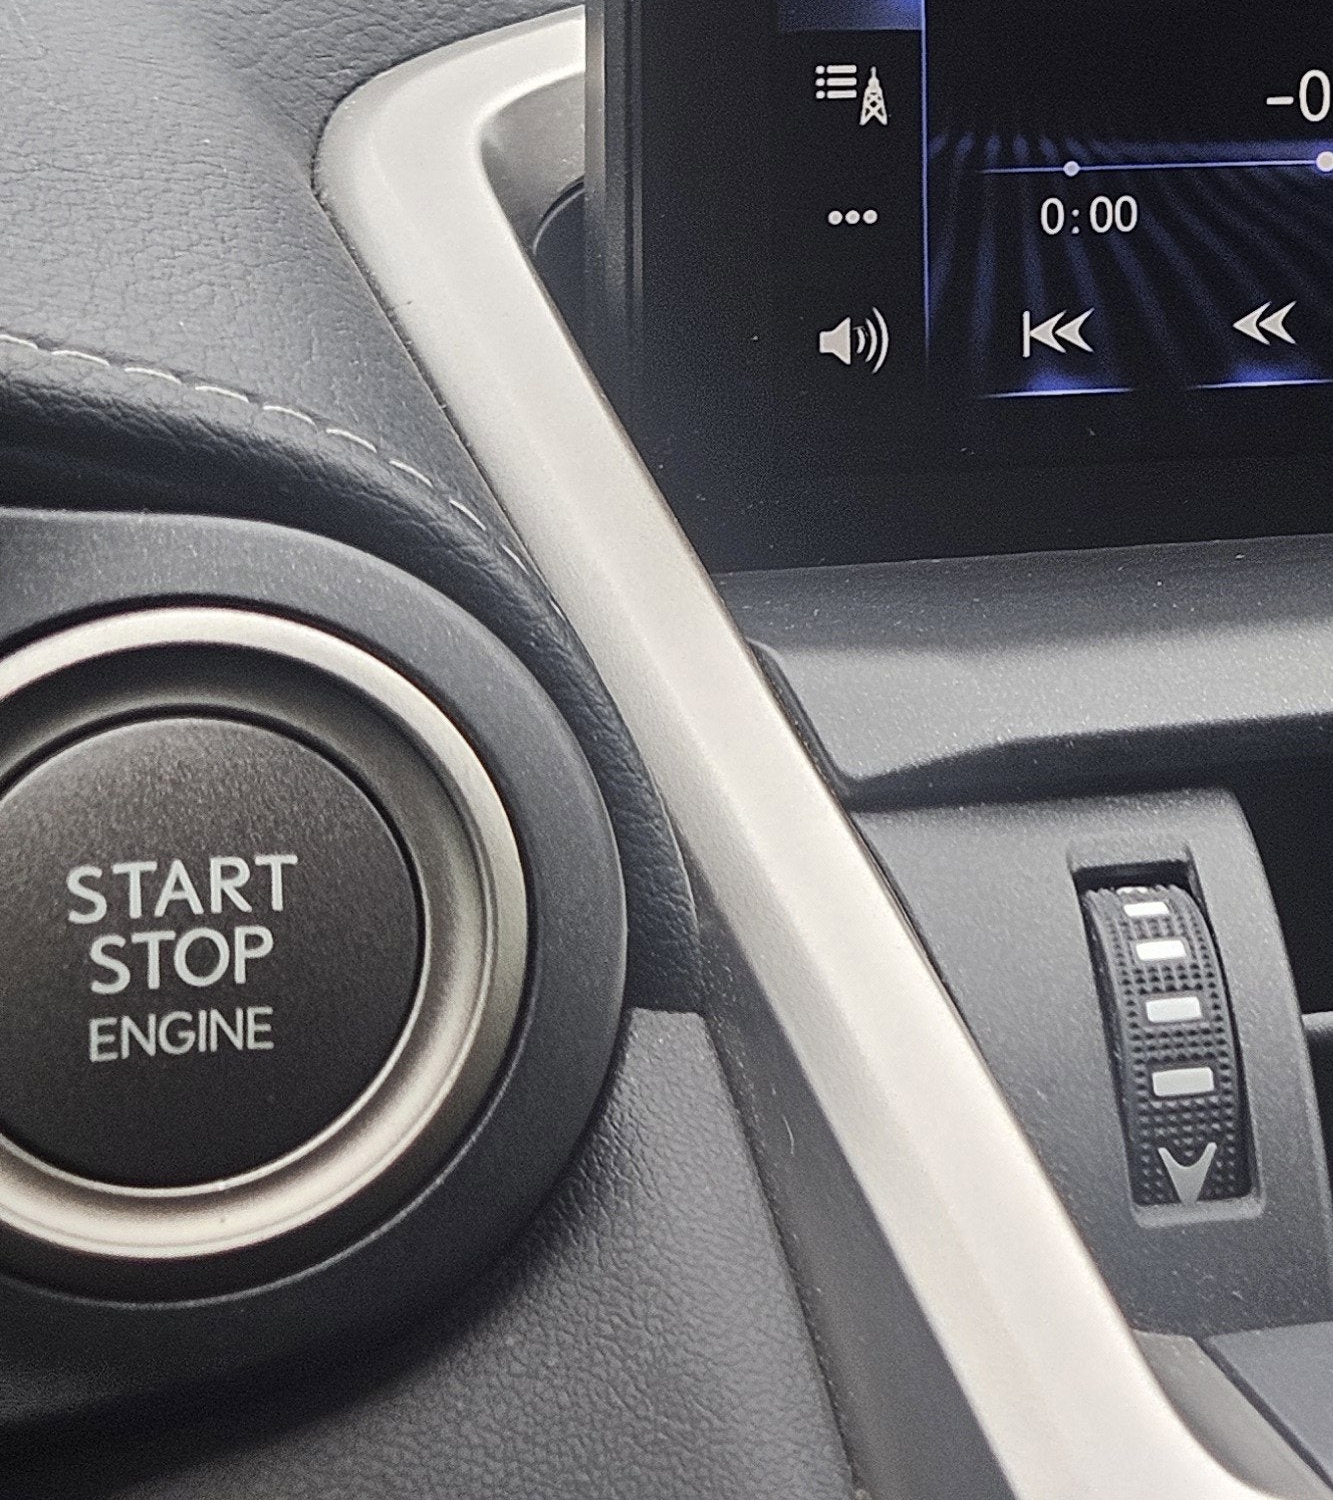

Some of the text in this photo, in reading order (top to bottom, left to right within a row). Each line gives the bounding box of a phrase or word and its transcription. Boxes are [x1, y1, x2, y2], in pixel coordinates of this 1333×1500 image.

[1040, 195, 1138, 235] 0:00
[66, 854, 299, 925] START
[89, 926, 275, 994] STOP
[88, 1006, 275, 1062] ENGINE
